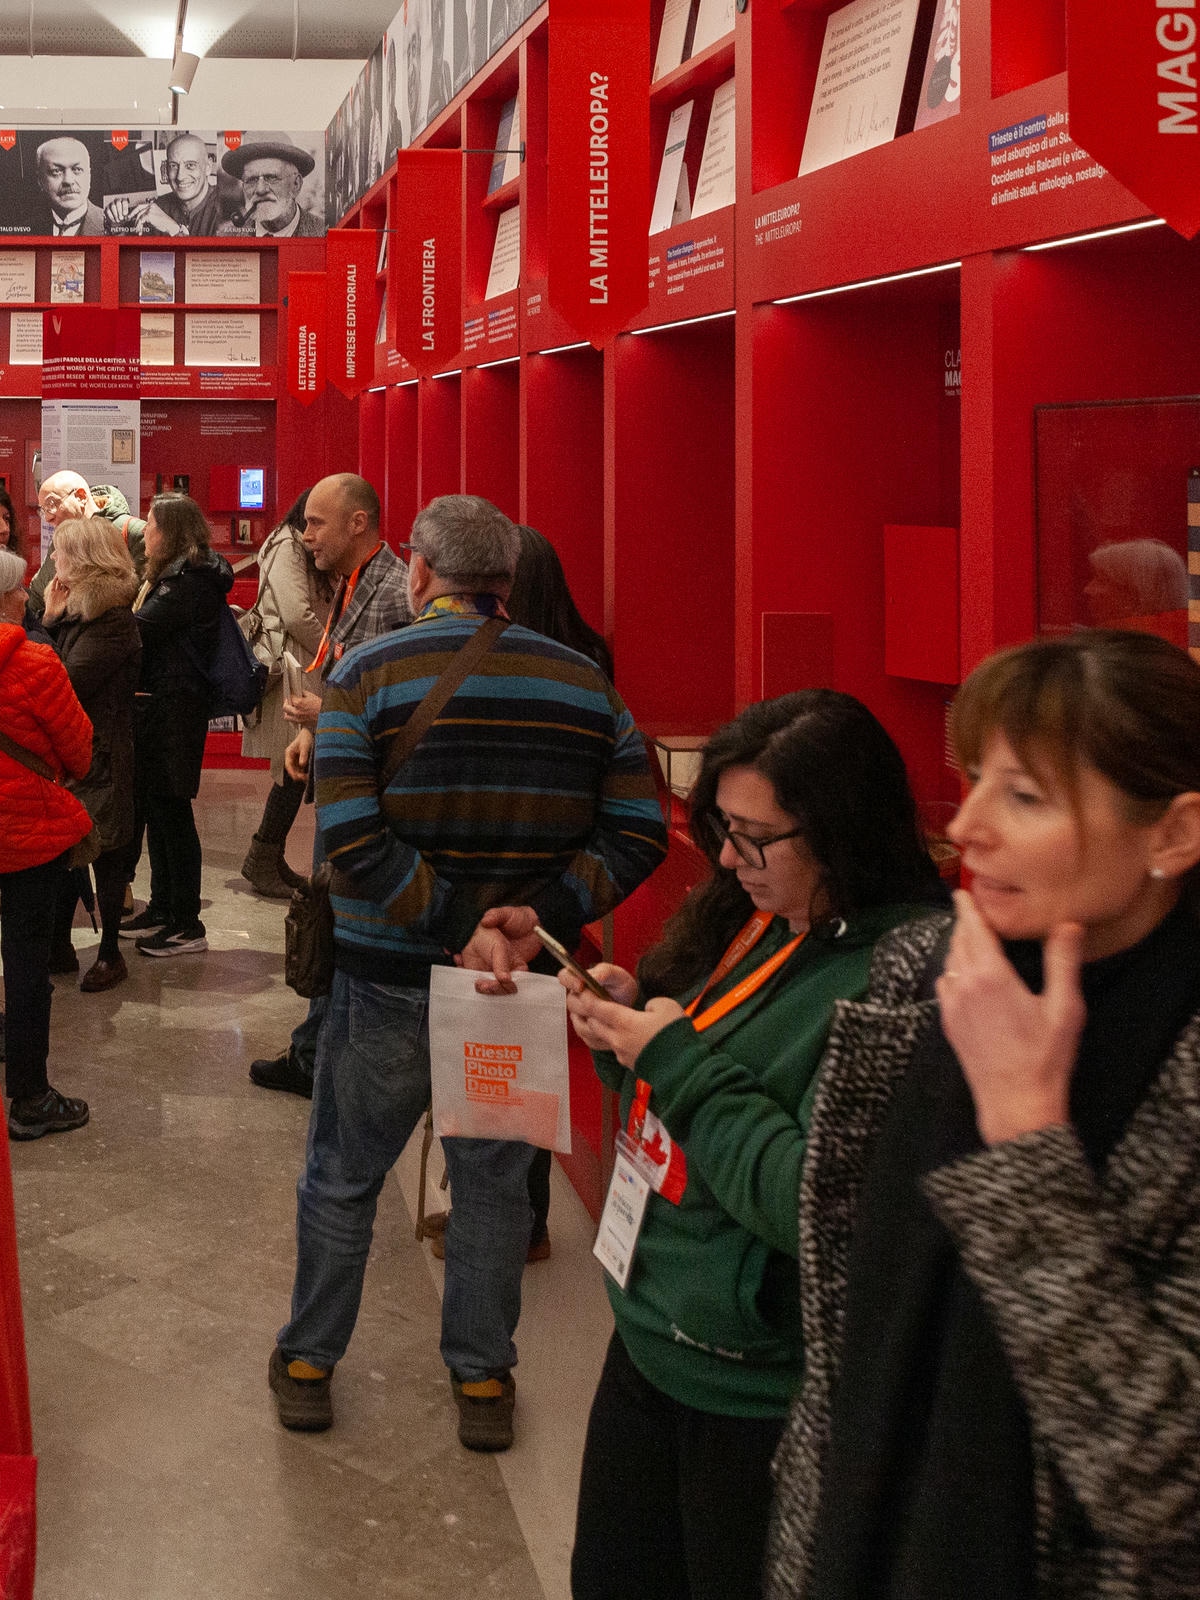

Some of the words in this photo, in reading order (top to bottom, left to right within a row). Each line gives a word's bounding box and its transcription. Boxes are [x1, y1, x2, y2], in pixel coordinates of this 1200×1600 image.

[991, 132, 1013, 147] Trieste
[1019, 125, 1024, 138] il
[1024, 120, 1046, 136] centro
[1047, 112, 1065, 128] della
[991, 150, 1007, 167] Nord
[1007, 142, 1041, 162] asburgico
[1041, 138, 1048, 150] di
[1049, 135, 1059, 148] un
[590, 72, 609, 268] MITTELEUROPA?
[991, 168, 1024, 186] Occidente
[1025, 161, 1036, 176] dei
[1037, 153, 1062, 173] Balcani
[991, 193, 998, 206] di
[998, 187, 1019, 204] infiniti
[1019, 181, 1038, 198] studi,
[1039, 172, 1075, 193] mitologie,
[762, 202, 800, 227] MITTELEUROPA?
[423, 238, 436, 327] FRONTIERA
[590, 274, 608, 304] LA
[347, 264, 357, 336] EDITORIALI
[309, 332, 317, 381] DIALETTO
[422, 332, 435, 350] LA
[299, 326, 307, 391] LETTERATURA
[346, 338, 356, 378] IMPRESE
[309, 382, 316, 391] IN
[467, 1043, 520, 1060] Trieste
[467, 1061, 514, 1078] Photo
[468, 1079, 505, 1097] Days
